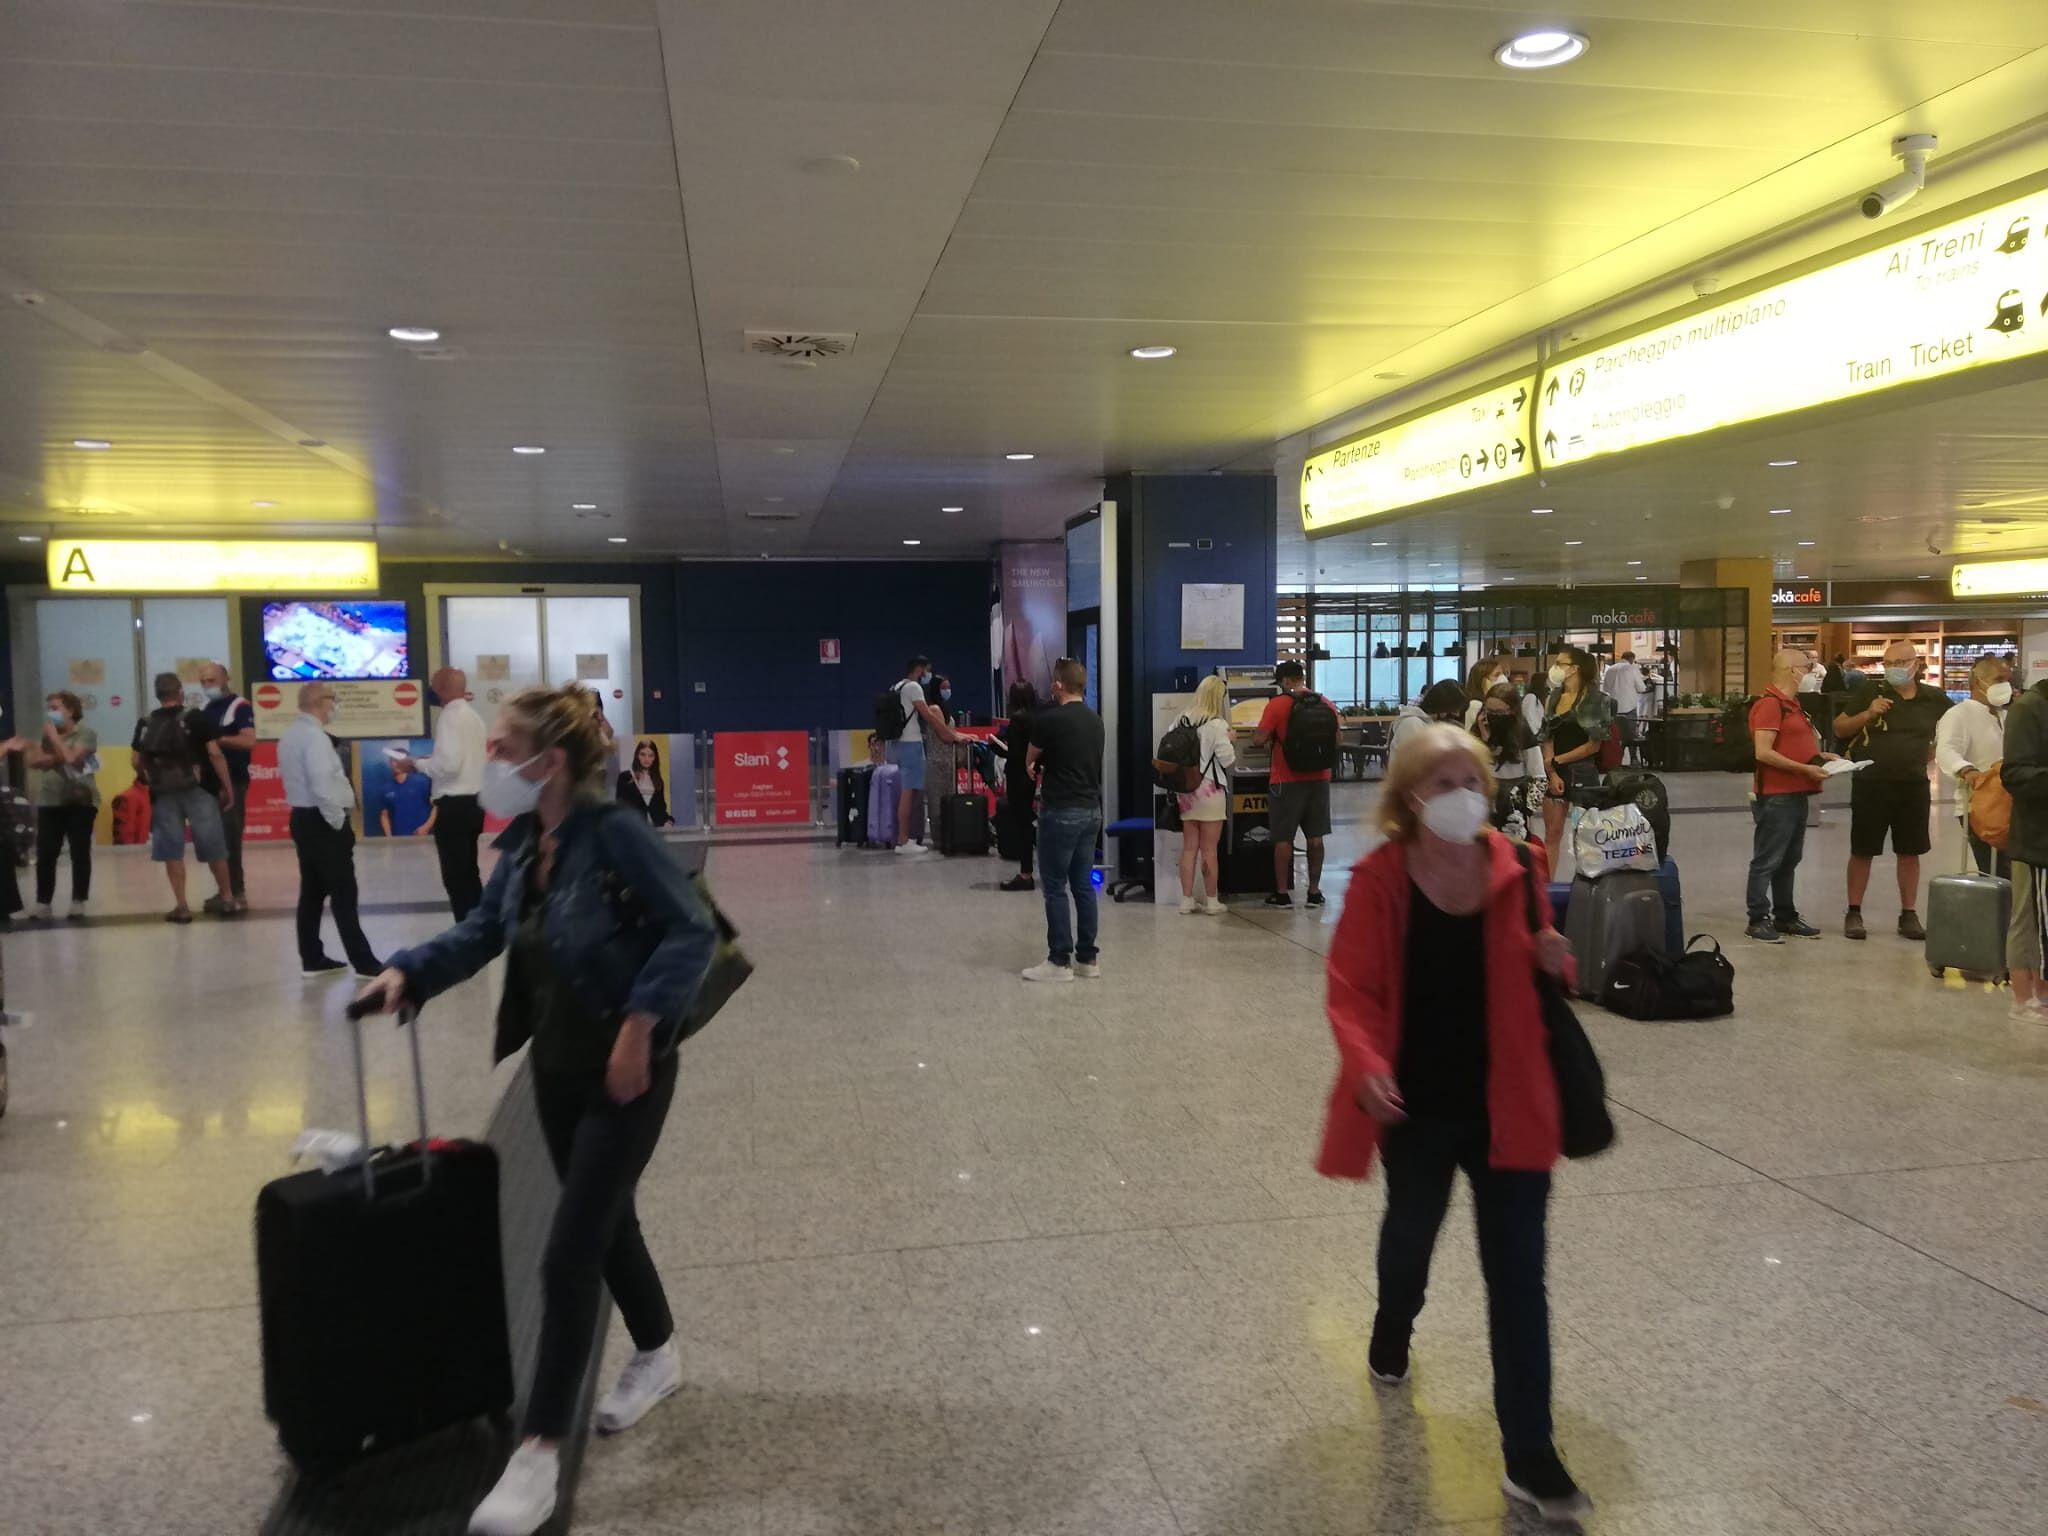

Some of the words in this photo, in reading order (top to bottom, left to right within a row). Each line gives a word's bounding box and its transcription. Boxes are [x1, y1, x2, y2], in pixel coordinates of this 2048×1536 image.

[1885, 247, 1912, 281] Ai
[1920, 220, 1987, 266] Treni
[1935, 259, 1982, 286] trains
[1593, 333, 1683, 374] Parcheggio
[1687, 296, 1787, 345] multipiano
[1845, 356, 1892, 384] Train
[1909, 330, 1974, 368] Ticket
[1333, 439, 1381, 469] Partenze
[61, 546, 96, 583] A
[734, 752, 770, 767] Slam
[1595, 819, 1651, 845] Summer
[1602, 843, 1654, 860] TEZENIS
